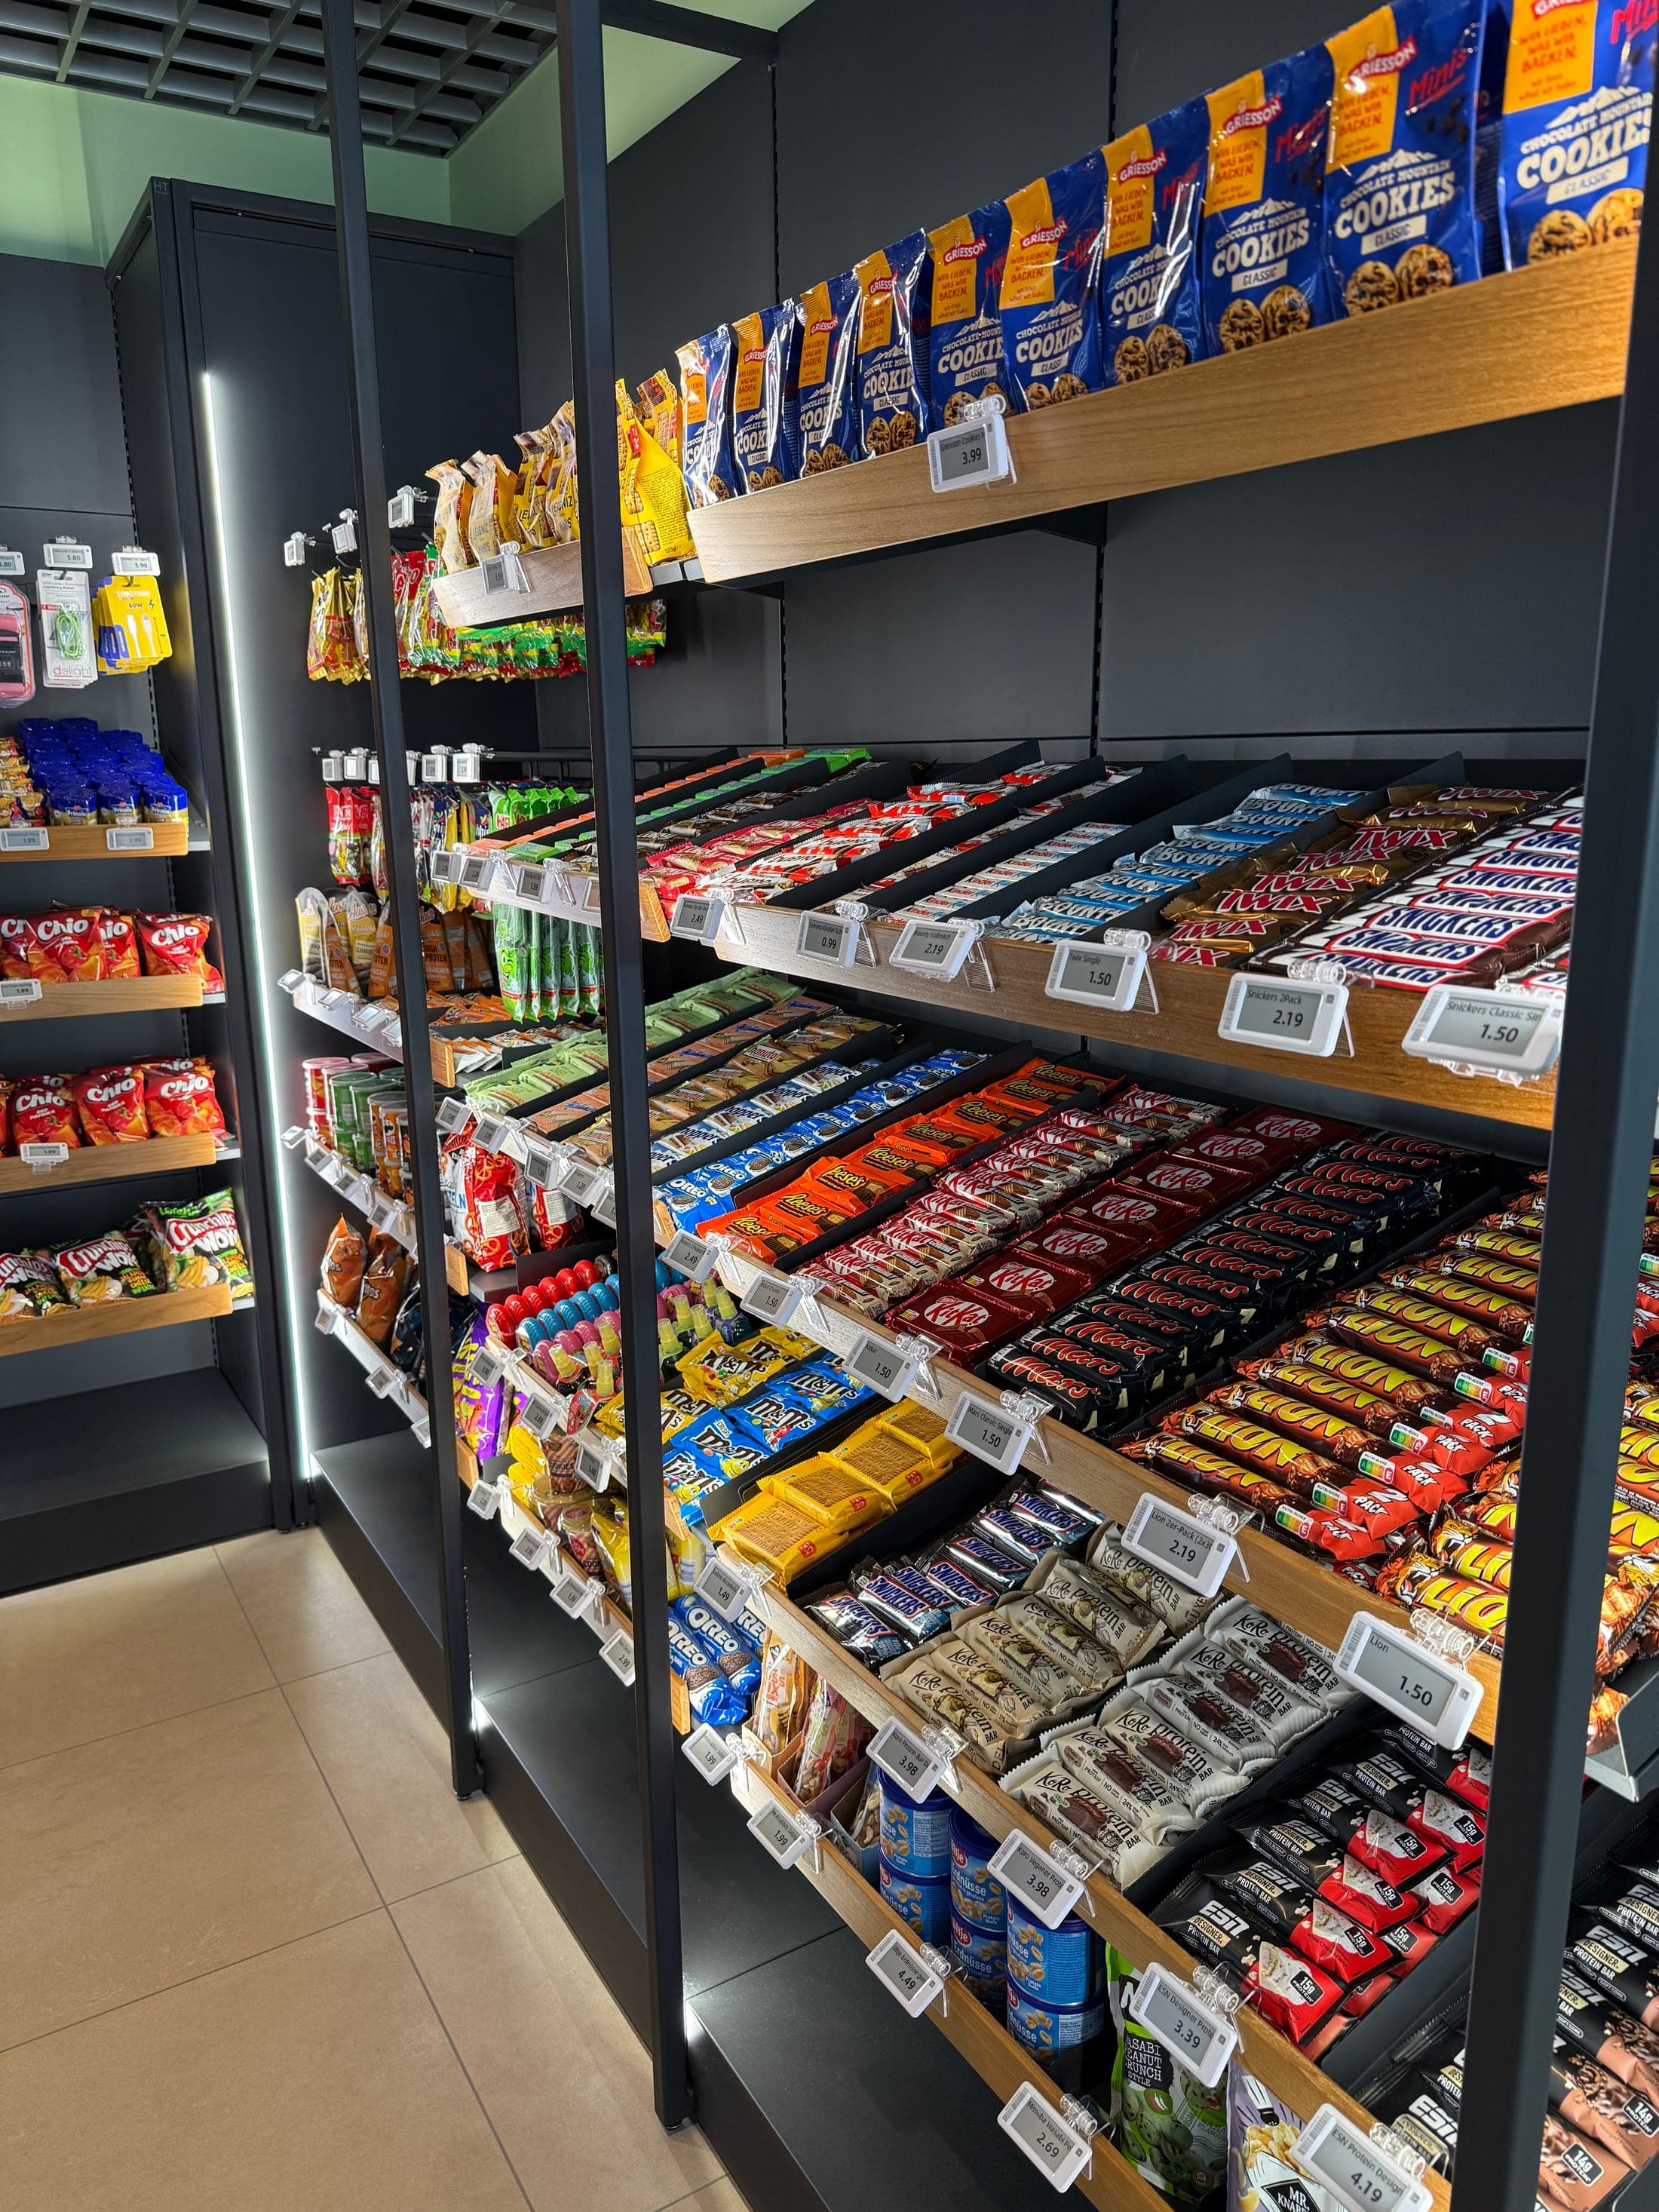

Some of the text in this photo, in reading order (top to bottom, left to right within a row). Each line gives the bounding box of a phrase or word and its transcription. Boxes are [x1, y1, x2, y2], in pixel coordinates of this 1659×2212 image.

[1225, 100, 1281, 136] GRIESSON
[1118, 152, 1167, 182] GRIESSON
[1334, 170, 1455, 240] COOKIES
[1020, 220, 1069, 248] GRIESSON
[1215, 219, 1265, 250] CHOCOLATE
[944, 238, 987, 263] GRIESSON
[1212, 218, 1310, 278] COOKIES
[937, 272, 949, 281] WIR
[1011, 268, 1044, 284] BACKEN.
[1243, 265, 1277, 287] CLASSIC
[939, 286, 968, 301] BACKEN.
[1015, 319, 1083, 364] COOKIES
[1016, 321, 1059, 340] CHOCOLATE
[942, 336, 977, 353] CHOCOLATE
[963, 366, 987, 382] CLASSIC
[962, 448, 982, 465] 3.99
[54, 665, 92, 678] delight
[38, 917, 89, 940] Chio
[691, 913, 703, 924] 2.49
[823, 925, 834, 933] Kinder
[1377, 906, 1525, 943] SNICKERS
[151, 925, 200, 946] Chio
[822, 937, 836, 950] 0.99
[925, 943, 944, 956] 2.19
[1082, 954, 1102, 966] Single
[1088, 971, 1112, 986] 1.50
[1247, 989, 1302, 1006] Snickers 2Pack
[1273, 1010, 1304, 1028] 2.19
[1448, 1000, 1542, 1023] Snickers Classic Sin
[1480, 1023, 1519, 1043] 1.50
[15, 1091, 66, 1112] Chio
[87, 1077, 136, 1103] Chio
[959, 1100, 1007, 1124] Reese's
[861, 1143, 914, 1170] Reese's
[710, 1163, 745, 1180] OREO
[671, 1179, 706, 1198] OREO
[785, 1193, 826, 1216] Reese's
[172, 1210, 235, 1249] Crunchips
[1044, 1234, 1109, 1256] KitKat
[685, 1253, 698, 1265] 2.49
[990, 1266, 1056, 1293] KitKat
[765, 1296, 778, 1307] 1.50
[1121, 1282, 1222, 1316] Mars
[926, 1299, 989, 1327] KitKat
[1065, 1321, 1163, 1356] Mars
[875, 1363, 891, 1379] 1.50
[1004, 1356, 1098, 1399] Mars
[1307, 1343, 1413, 1394] LION
[970, 1407, 1013, 1436] Mars Classic Single
[1243, 1388, 1351, 1440] LION
[981, 1430, 1001, 1447] 1.50
[1200, 1412, 1309, 1470] LION
[1158, 1437, 1266, 1487] LION
[1403, 1462, 1436, 1486] PACK
[1020, 1493, 1081, 1526] SNICKERS
[1355, 1495, 1388, 1517] PACK
[988, 1510, 1053, 1548] SNICKERS
[1152, 1511, 1194, 1540] Lion 2er-Pack
[963, 1538, 1023, 1572] SNICKERS
[1169, 1540, 1196, 1562] 2.19
[718, 1586, 730, 1600] 1.49
[929, 1565, 989, 1603] SNICKERS
[866, 1580, 928, 1616] SNICKERS
[688, 1608, 738, 1652] OREO
[1233, 1614, 1332, 1682] KoRo protein
[1369, 1634, 1390, 1653] Lion
[618, 1654, 630, 1667] 2.99
[1191, 1646, 1225, 1670] KoRo
[1398, 1674, 1434, 1707] 1.50
[893, 1731, 925, 1763] Koro Protein Bar
[985, 1731, 998, 1742] BAR
[1115, 1708, 1214, 1781] KoRo protein BAR
[1400, 1726, 1419, 1745] PROTEIN
[704, 1751, 716, 1765] 1.99
[899, 1756, 918, 1775] 3.98
[1368, 1753, 1416, 1783] ESN
[1356, 1769, 1375, 1789] PROTEIN
[1035, 1770, 1140, 1849] KoRo protein BAR
[774, 1830, 789, 1845] 1.99
[1464, 1819, 1477, 1836] 15g
[1018, 1846, 1029, 1860] Koro
[1029, 1855, 1051, 1877] Veganer
[952, 1866, 986, 1896] Erdnüsse
[1027, 1874, 1050, 1897] 3.98
[1236, 1876, 1271, 1904] PROTEIN BAR
[1199, 1900, 1250, 1936] ESN
[1209, 1942, 1220, 1956] BAR
[1586, 1925, 1648, 1965] ESN
[901, 1953, 919, 1977] Erdnüsse
[1573, 1946, 1615, 1980] PROTEIN BAR
[898, 1971, 916, 1990] 4.49
[1302, 1976, 1316, 1995] 15g
[1158, 1983, 1171, 1999] ESN
[1170, 1994, 1197, 2022] Designer
[1173, 2018, 1201, 2048] 3.39
[1127, 2072, 1151, 2088] STYLE
[1026, 2101, 1066, 2146] Mitsuba Wasabi
[1635, 2103, 1654, 2125] 14g
[1036, 2132, 1060, 2159] 2.69
[1331, 2128, 1404, 2196] ESN Protein Design
[1289, 2186, 1309, 2210] MR.
[1351, 2172, 1383, 2202] 4.19
